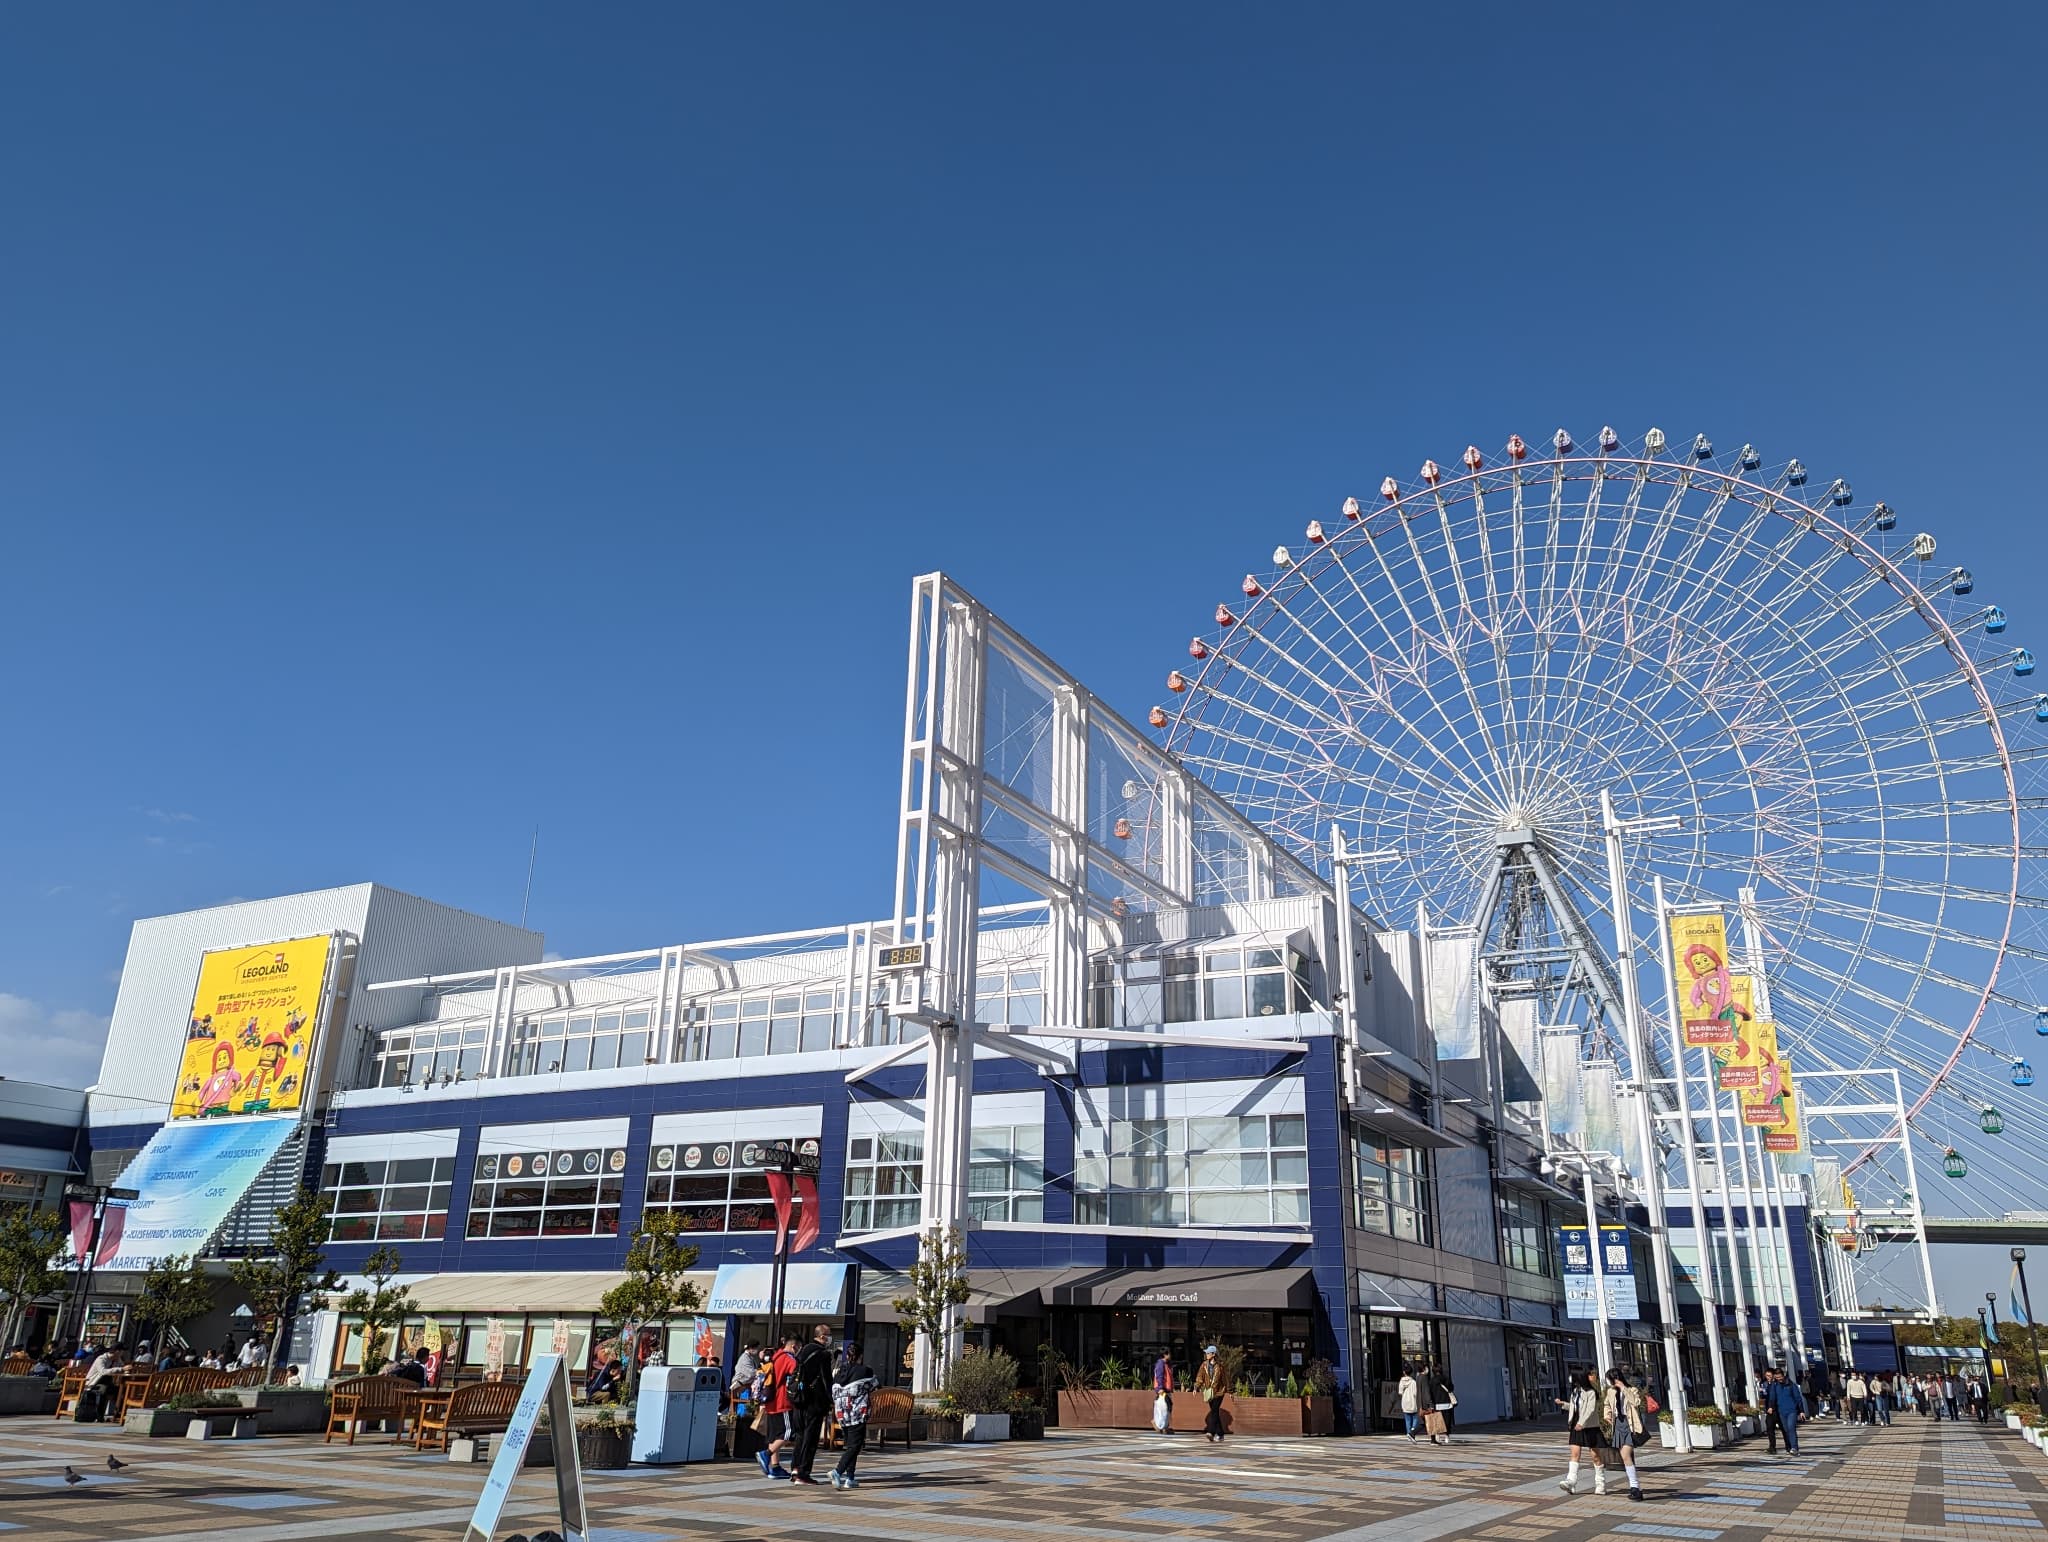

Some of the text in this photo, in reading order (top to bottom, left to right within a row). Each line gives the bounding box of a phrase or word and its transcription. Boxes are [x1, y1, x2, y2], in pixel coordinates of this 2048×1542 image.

[242, 962, 289, 978] LEGOLAND
[205, 1187, 228, 1198] CAFE
[1126, 1293, 1155, 1301] Mother
[1156, 1293, 1178, 1302] Moon
[713, 1299, 761, 1310] TEMPOZAN
